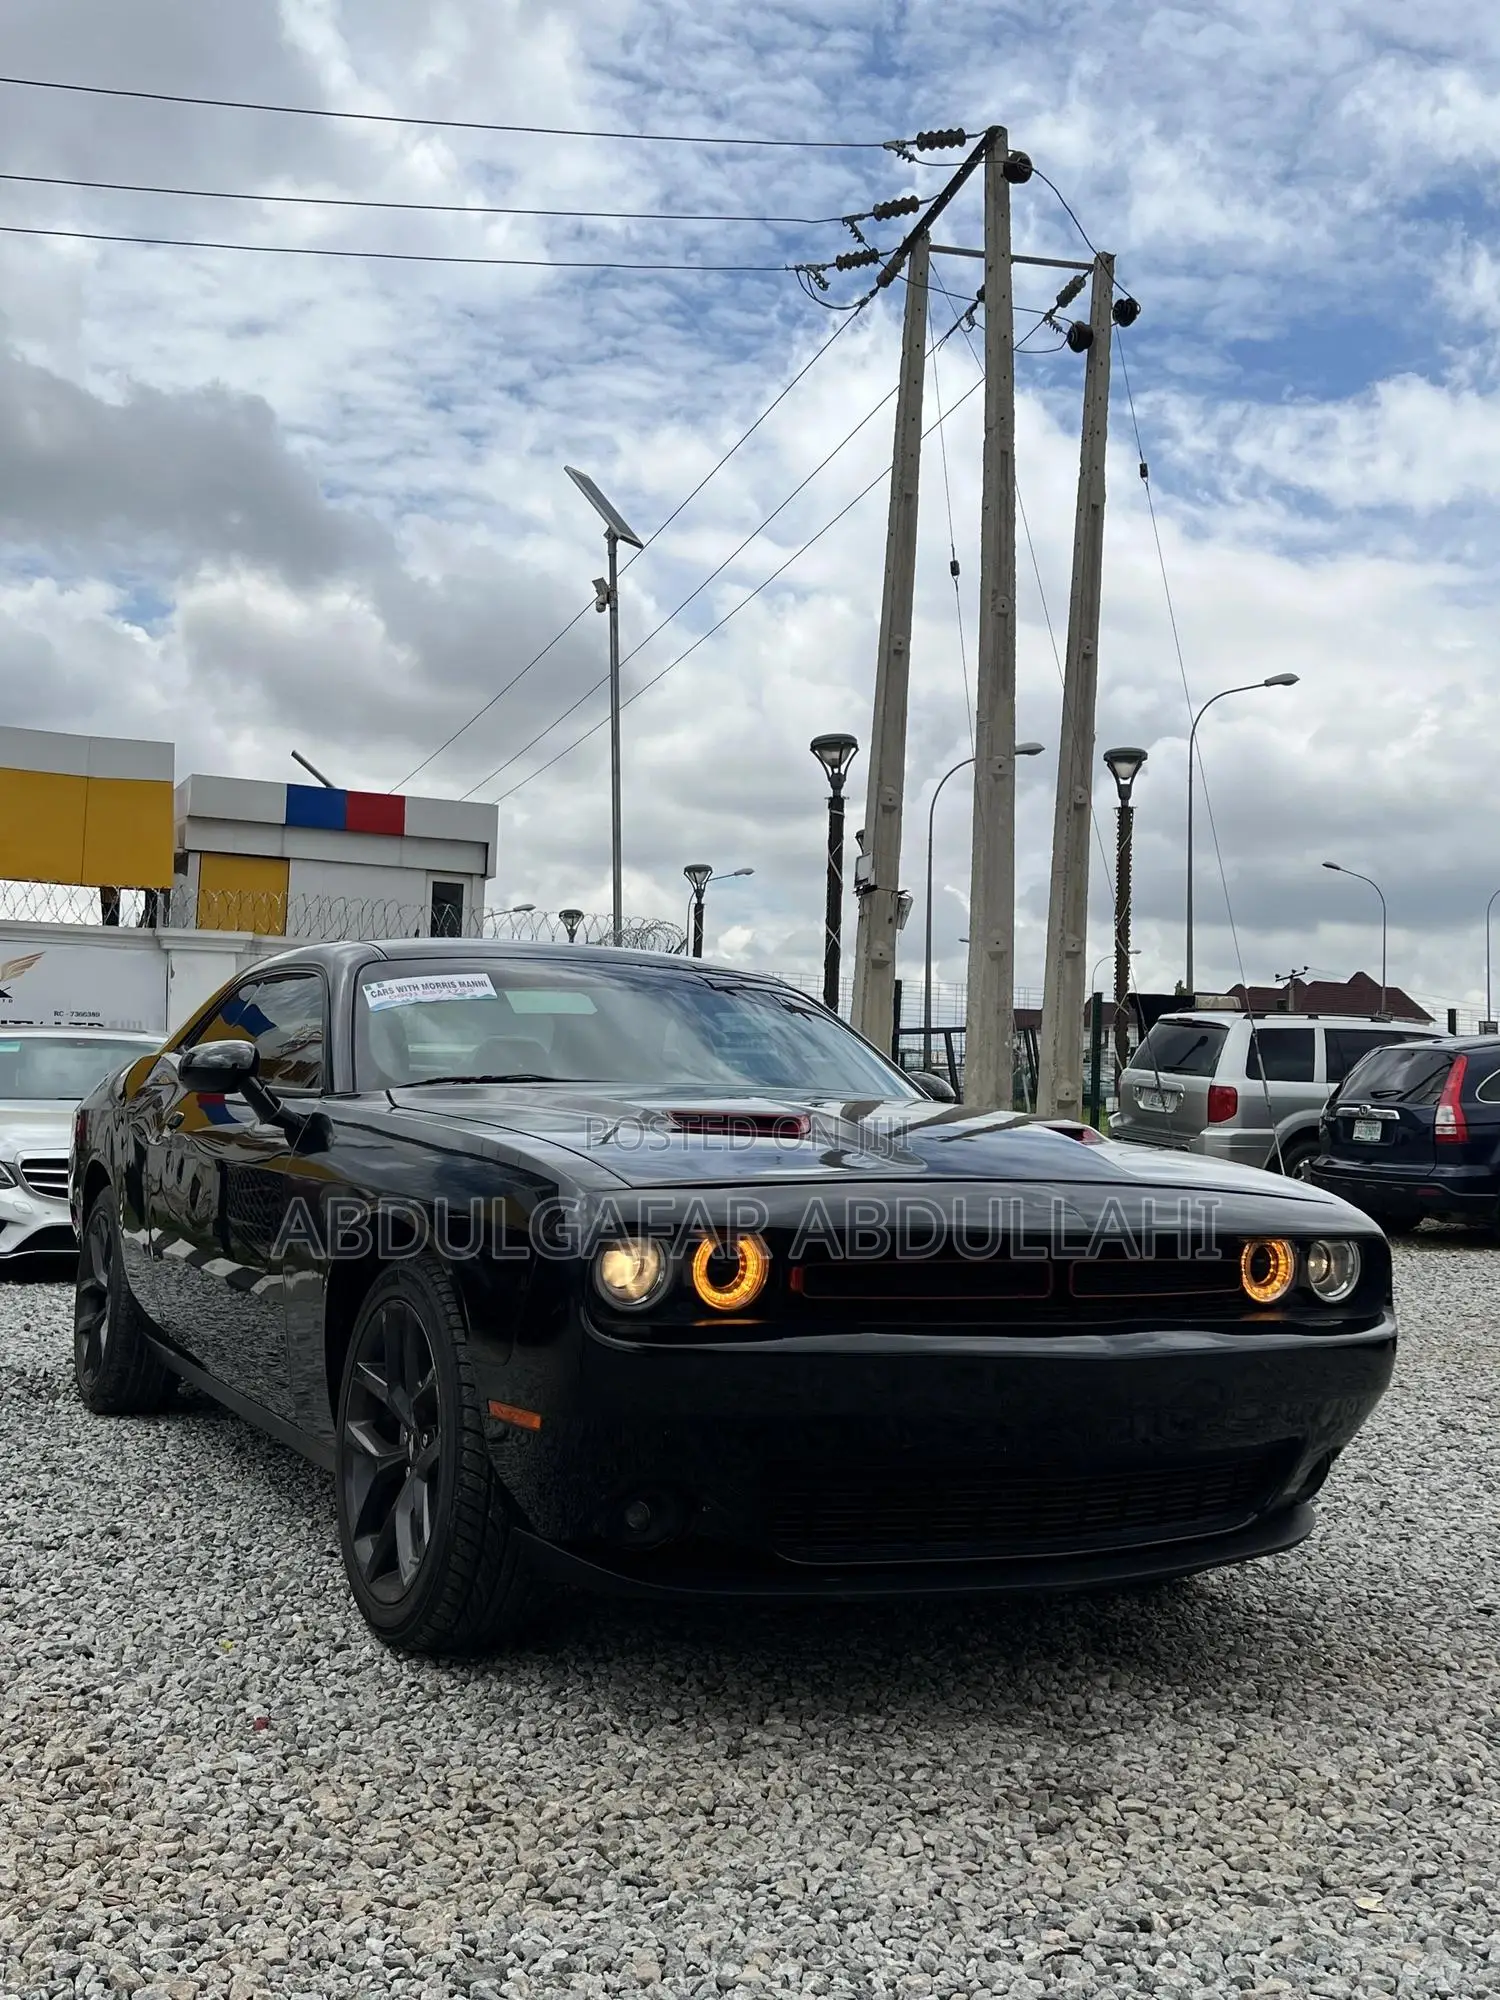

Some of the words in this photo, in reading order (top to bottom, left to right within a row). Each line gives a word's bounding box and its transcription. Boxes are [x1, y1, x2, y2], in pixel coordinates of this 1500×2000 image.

[370, 988, 394, 998] CARS
[395, 984, 420, 993] WITH
[421, 981, 457, 991] MORRIS
[458, 979, 488, 989] MANNI
